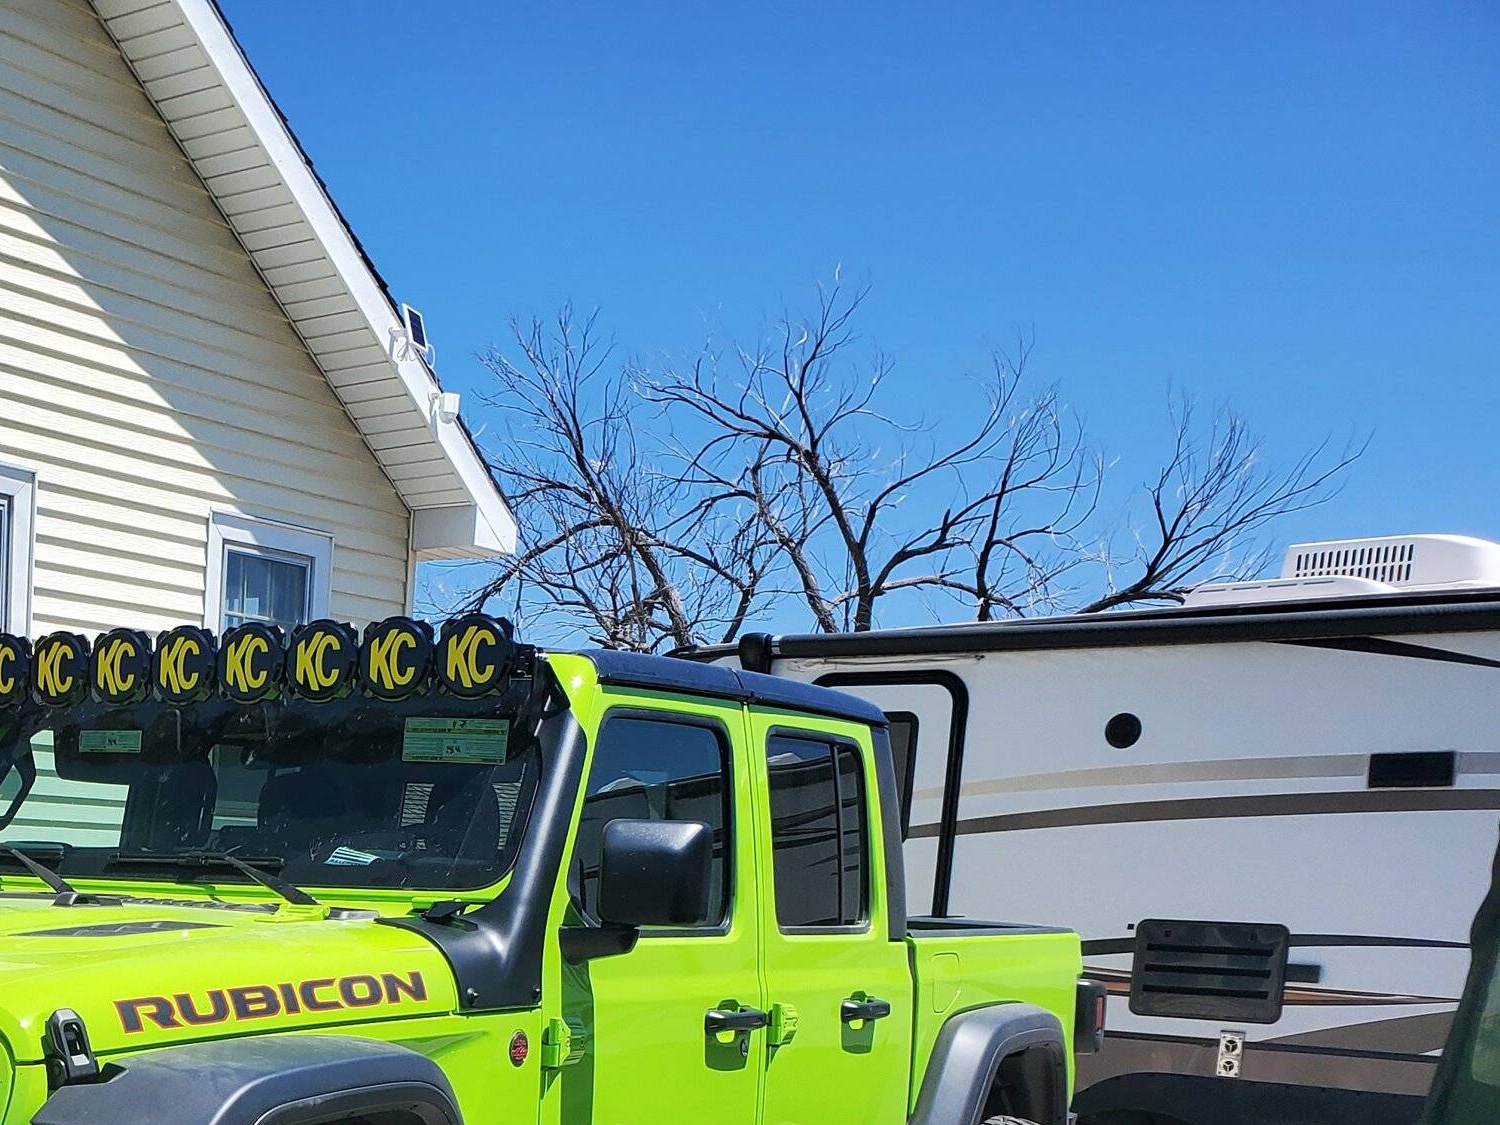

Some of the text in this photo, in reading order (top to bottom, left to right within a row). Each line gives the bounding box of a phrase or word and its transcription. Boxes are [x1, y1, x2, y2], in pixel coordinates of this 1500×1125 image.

[36, 642, 74, 696] KC
[97, 639, 135, 695] KC
[158, 637, 201, 693] KC
[226, 634, 269, 690] KC
[295, 632, 342, 690] KC
[369, 629, 417, 690] KC
[446, 626, 496, 688] KC
[112, 970, 428, 1034] RUBICON
